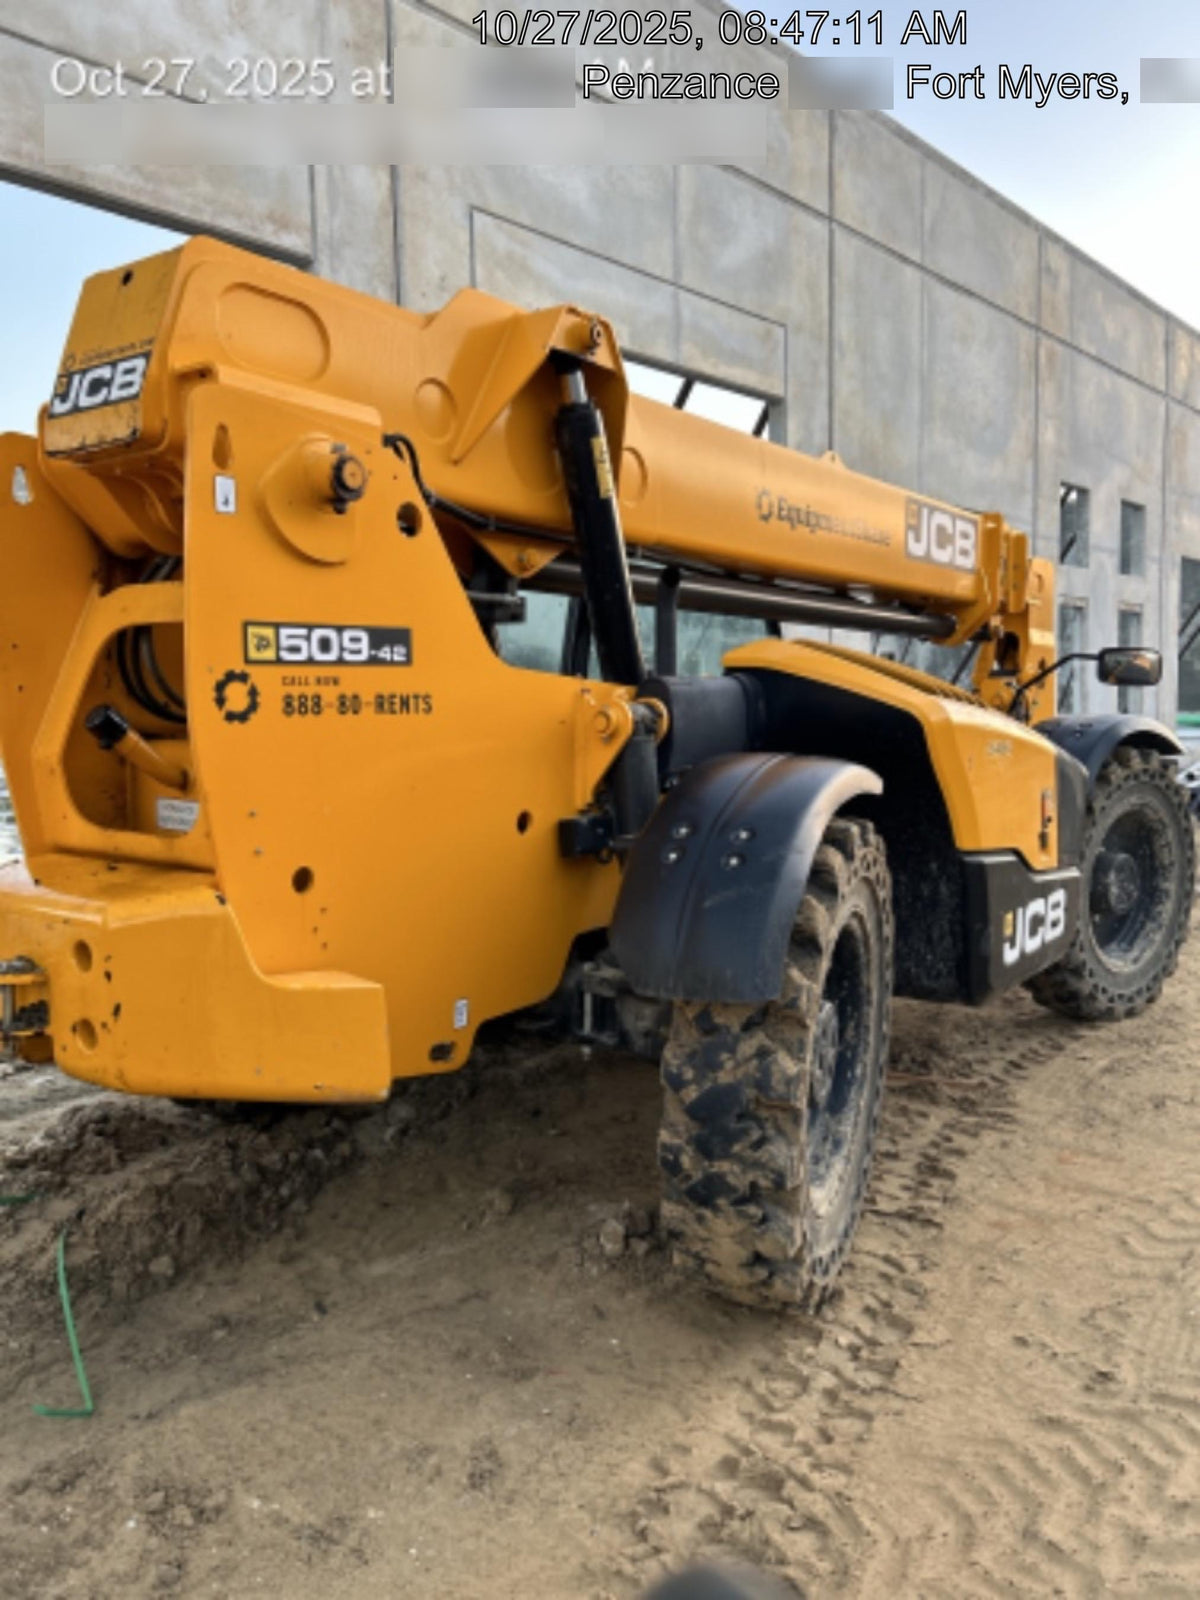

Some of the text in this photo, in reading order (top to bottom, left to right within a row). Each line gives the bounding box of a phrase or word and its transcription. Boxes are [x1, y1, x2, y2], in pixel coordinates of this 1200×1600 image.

[51, 355, 148, 416] JCB
[905, 504, 979, 571] JCB
[281, 676, 340, 687] CALL NOW
[1002, 887, 1067, 966] JCB
